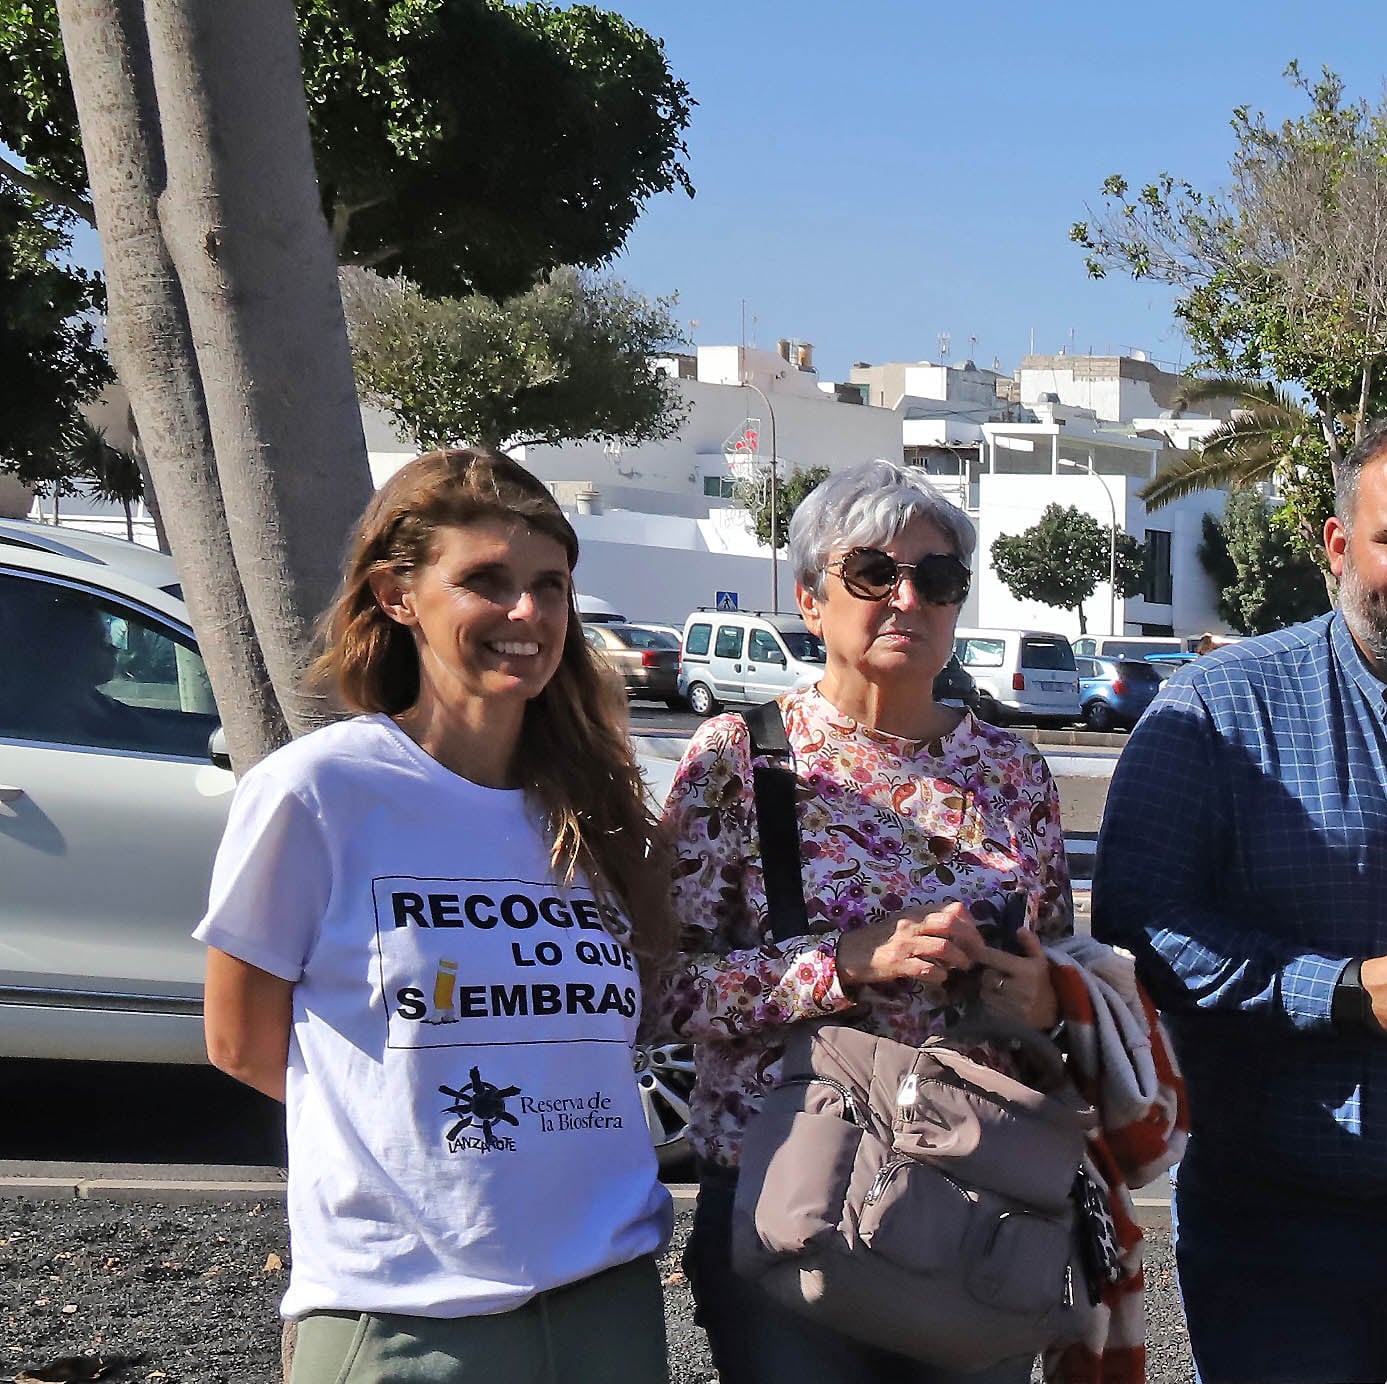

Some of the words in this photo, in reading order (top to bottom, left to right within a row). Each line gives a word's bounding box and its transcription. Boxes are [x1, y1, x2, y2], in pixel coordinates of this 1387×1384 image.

[392, 892, 634, 935] RECOGES
[512, 941, 563, 966] LO
[576, 941, 634, 972] QUE
[520, 1096, 584, 1114] Reserva
[588, 1091, 612, 1110] de
[541, 1114, 554, 1132] la
[558, 1110, 624, 1131] Biosfera
